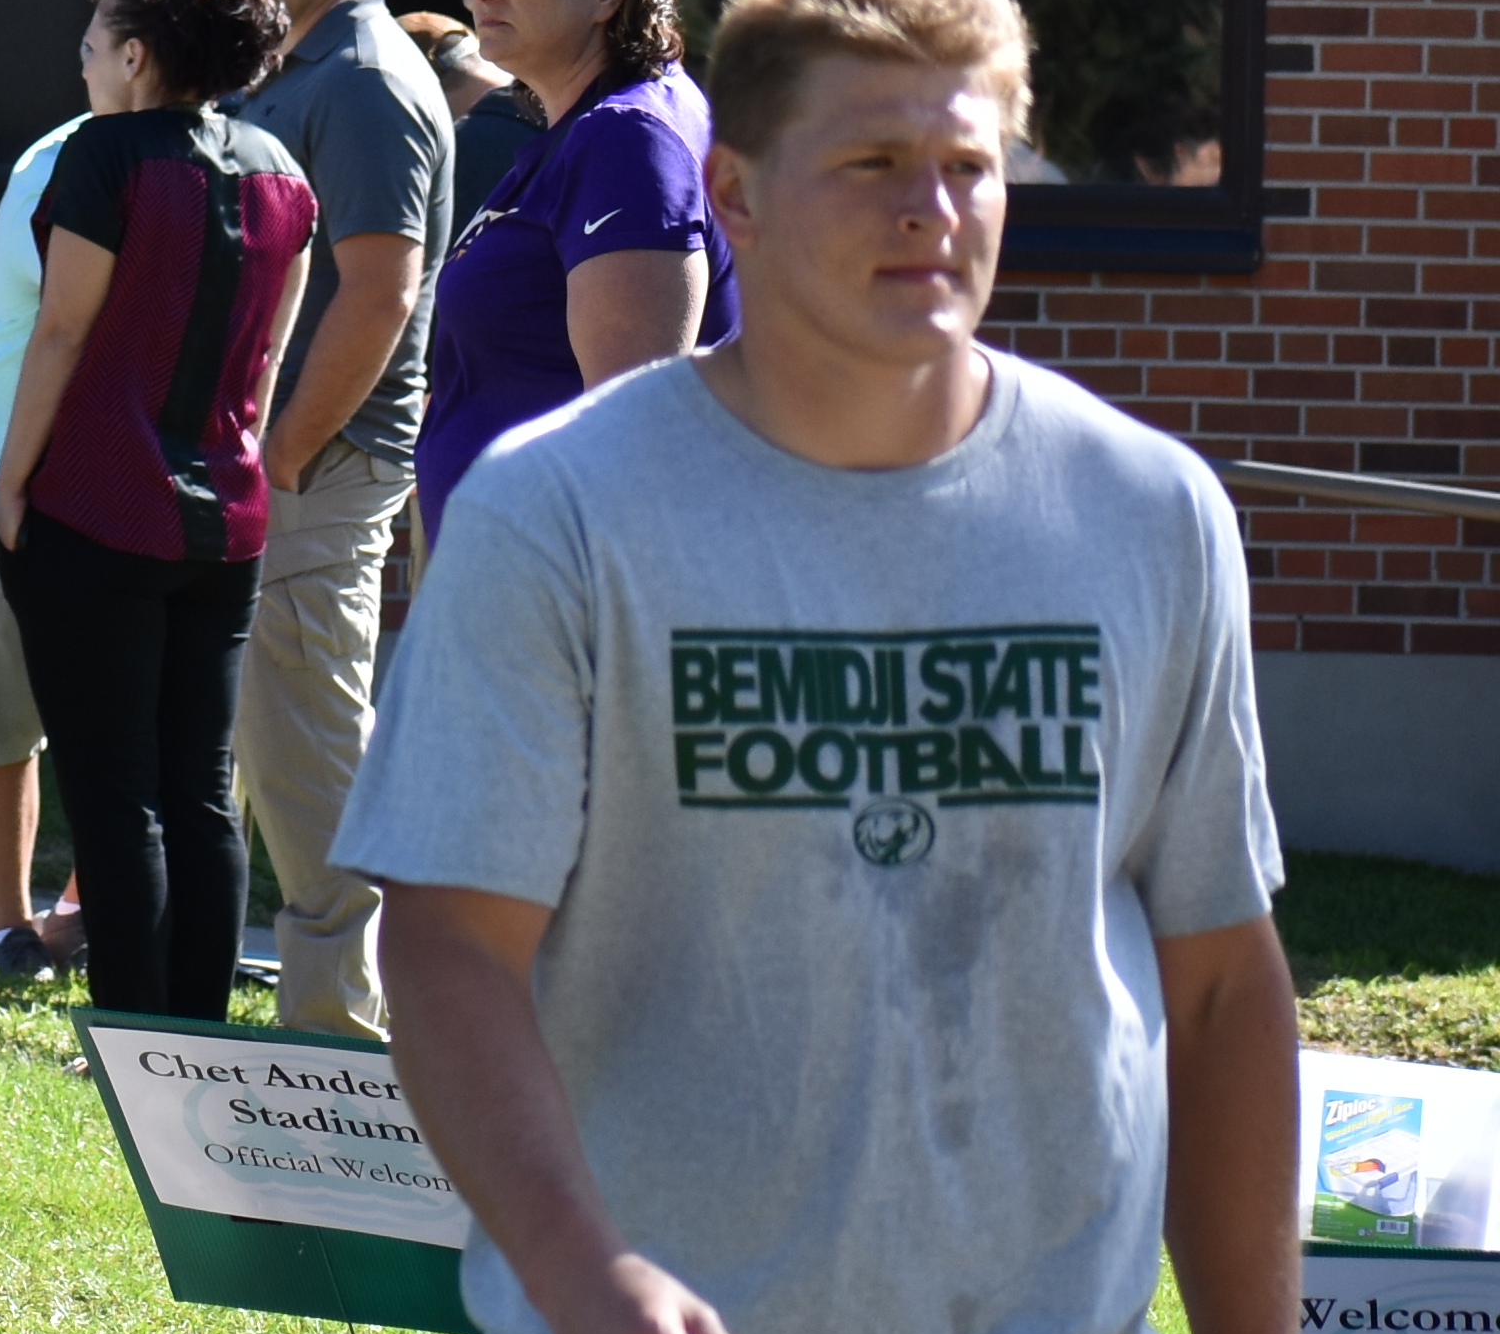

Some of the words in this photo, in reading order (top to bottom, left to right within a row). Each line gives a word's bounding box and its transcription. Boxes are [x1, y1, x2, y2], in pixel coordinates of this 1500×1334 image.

[670, 643, 908, 726] BEMIDJI
[920, 641, 1100, 724] STATE
[675, 724, 1100, 796] FOOTBALL
[139, 1051, 250, 1085] Chet
[264, 1063, 402, 1101] Ander
[229, 1098, 423, 1144] Stadium
[1325, 1099, 1377, 1126] Ziploc
[204, 1143, 323, 1175] Official
[1301, 1297, 1500, 1333] Welcom
